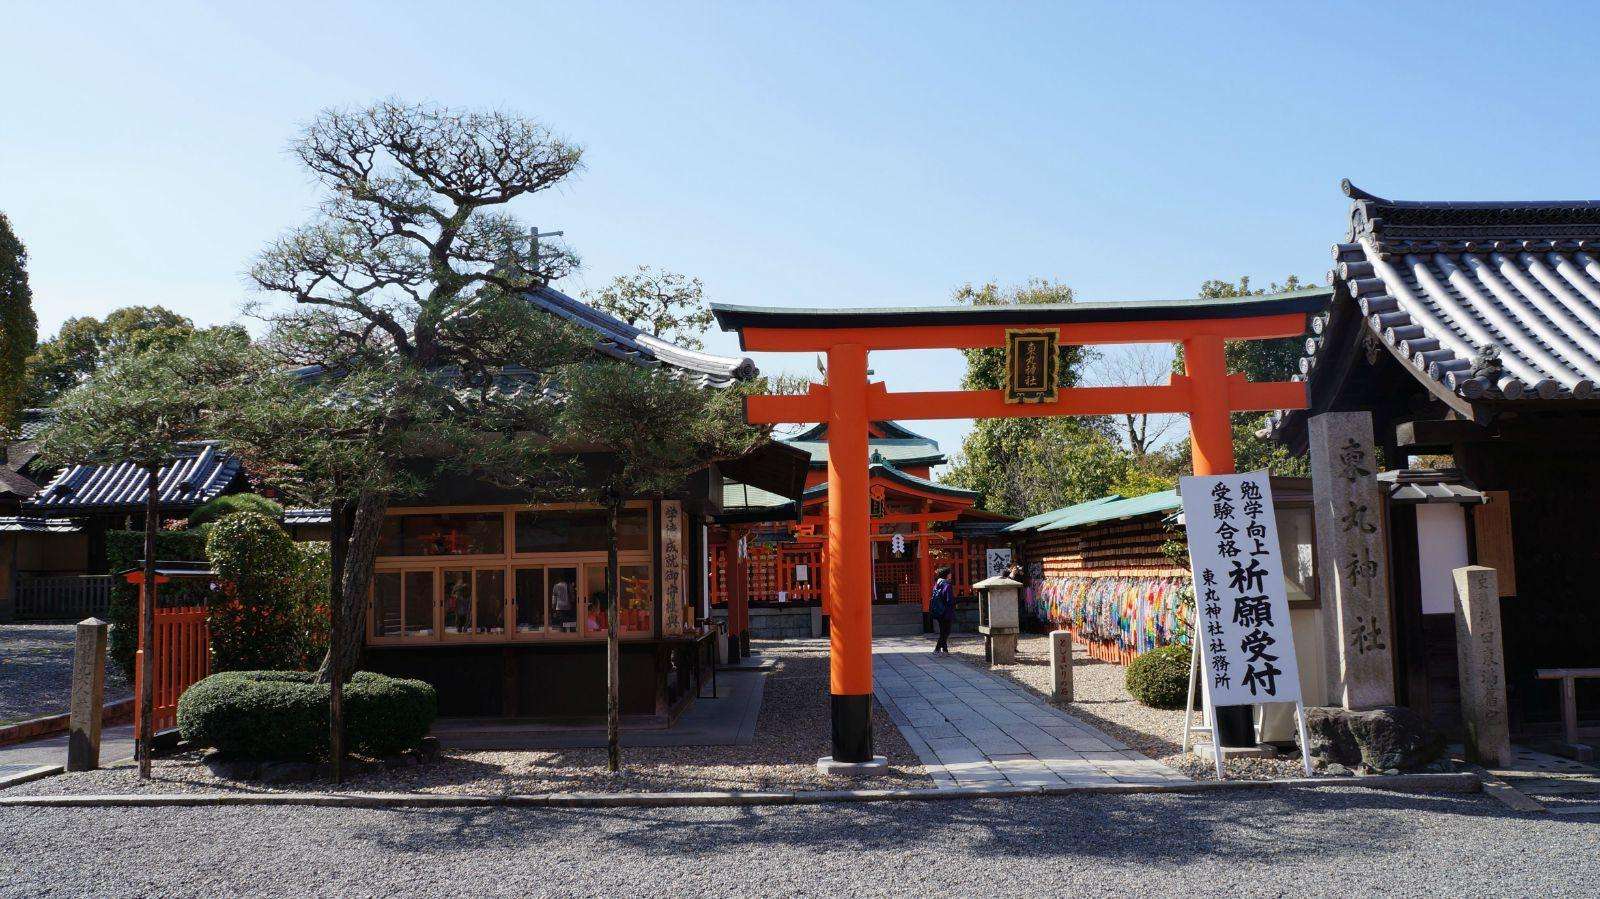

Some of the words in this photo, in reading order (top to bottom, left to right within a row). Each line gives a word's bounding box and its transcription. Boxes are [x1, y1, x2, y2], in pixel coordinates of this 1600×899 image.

[1211, 481, 1242, 558] 受験合格
[1240, 481, 1270, 557] 勉学向上
[1339, 437, 1386, 654] 東丸神社
[1202, 568, 1231, 690] 東丸神社社務所
[1228, 559, 1282, 697] 祈願受付
